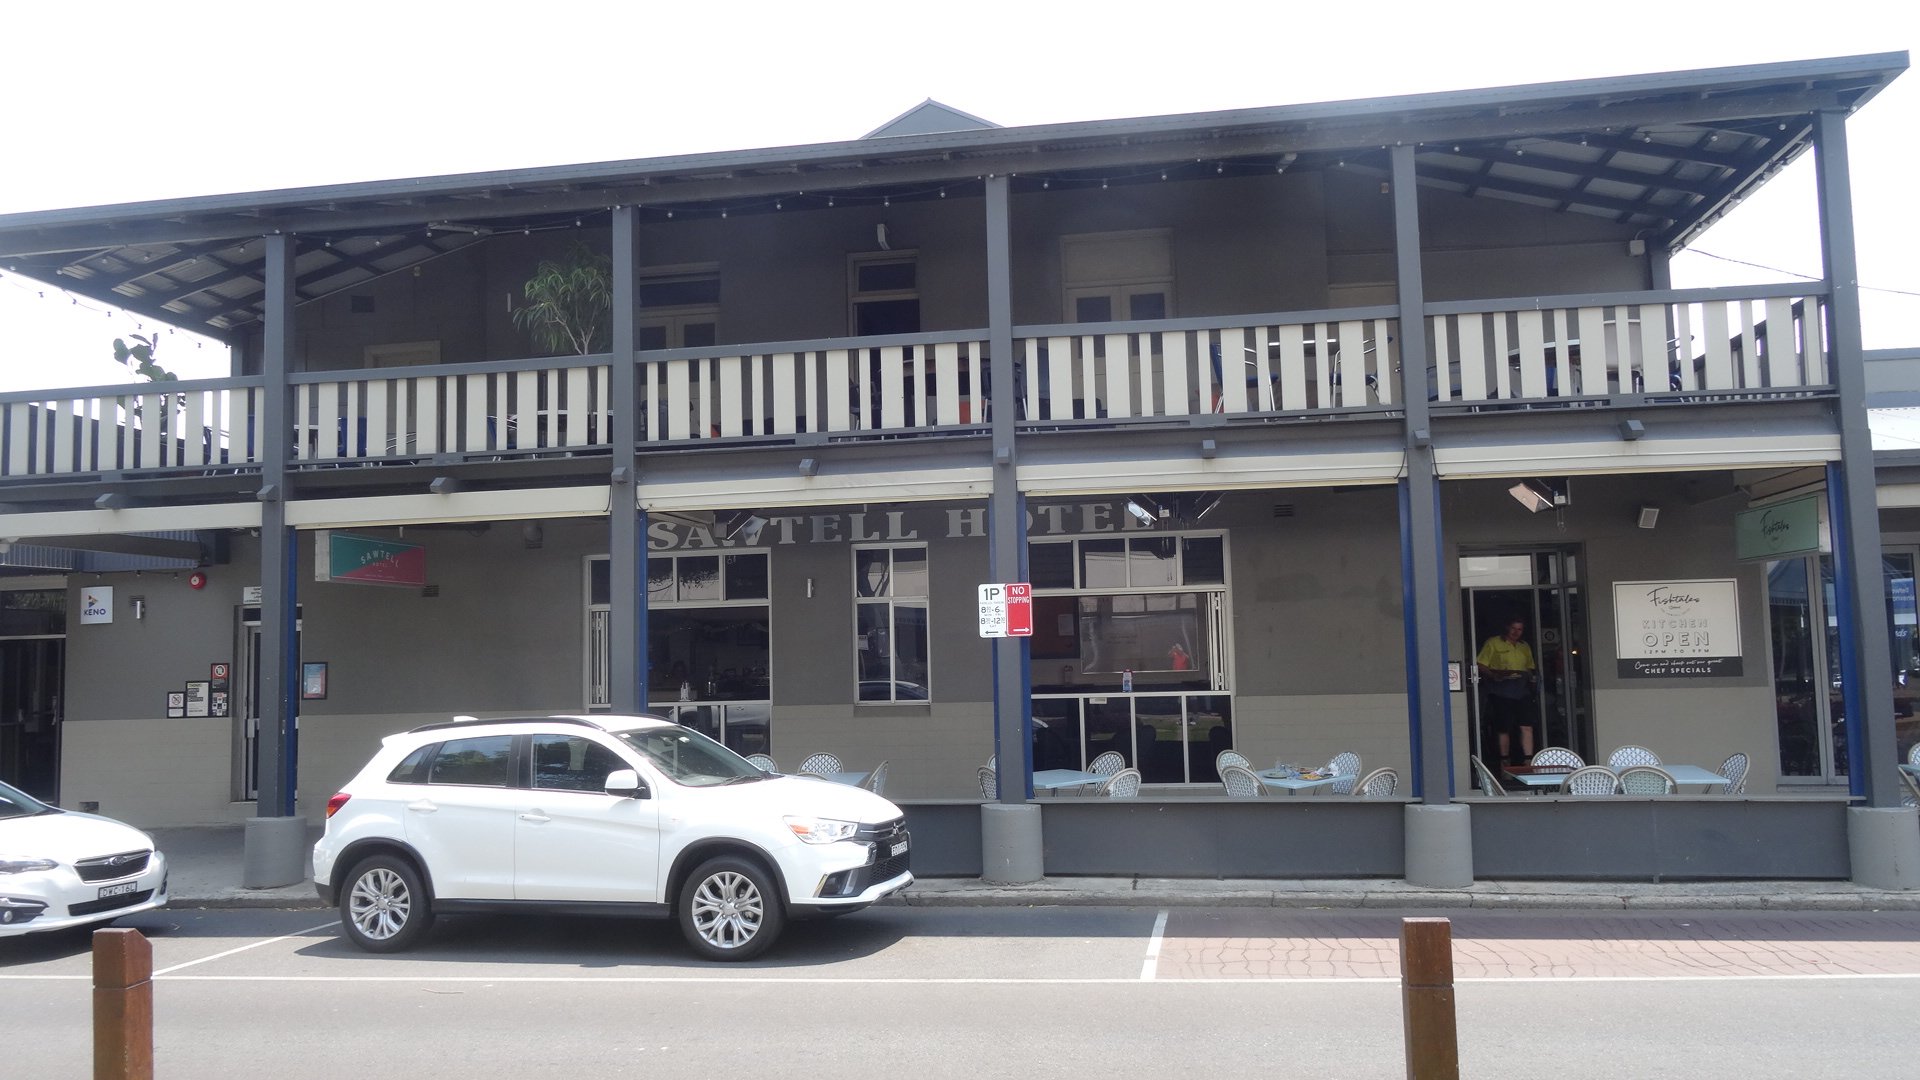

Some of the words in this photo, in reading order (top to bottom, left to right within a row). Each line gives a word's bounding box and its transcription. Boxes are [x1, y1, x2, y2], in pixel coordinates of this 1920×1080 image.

[360, 550, 400, 568] SAWTELL
[984, 588, 999, 600] 1P
[1012, 586, 1024, 595] NO
[1008, 596, 1029, 604] STOPPING
[1643, 619, 1708, 629] KITCHEN
[1643, 631, 1709, 647] OPEN
